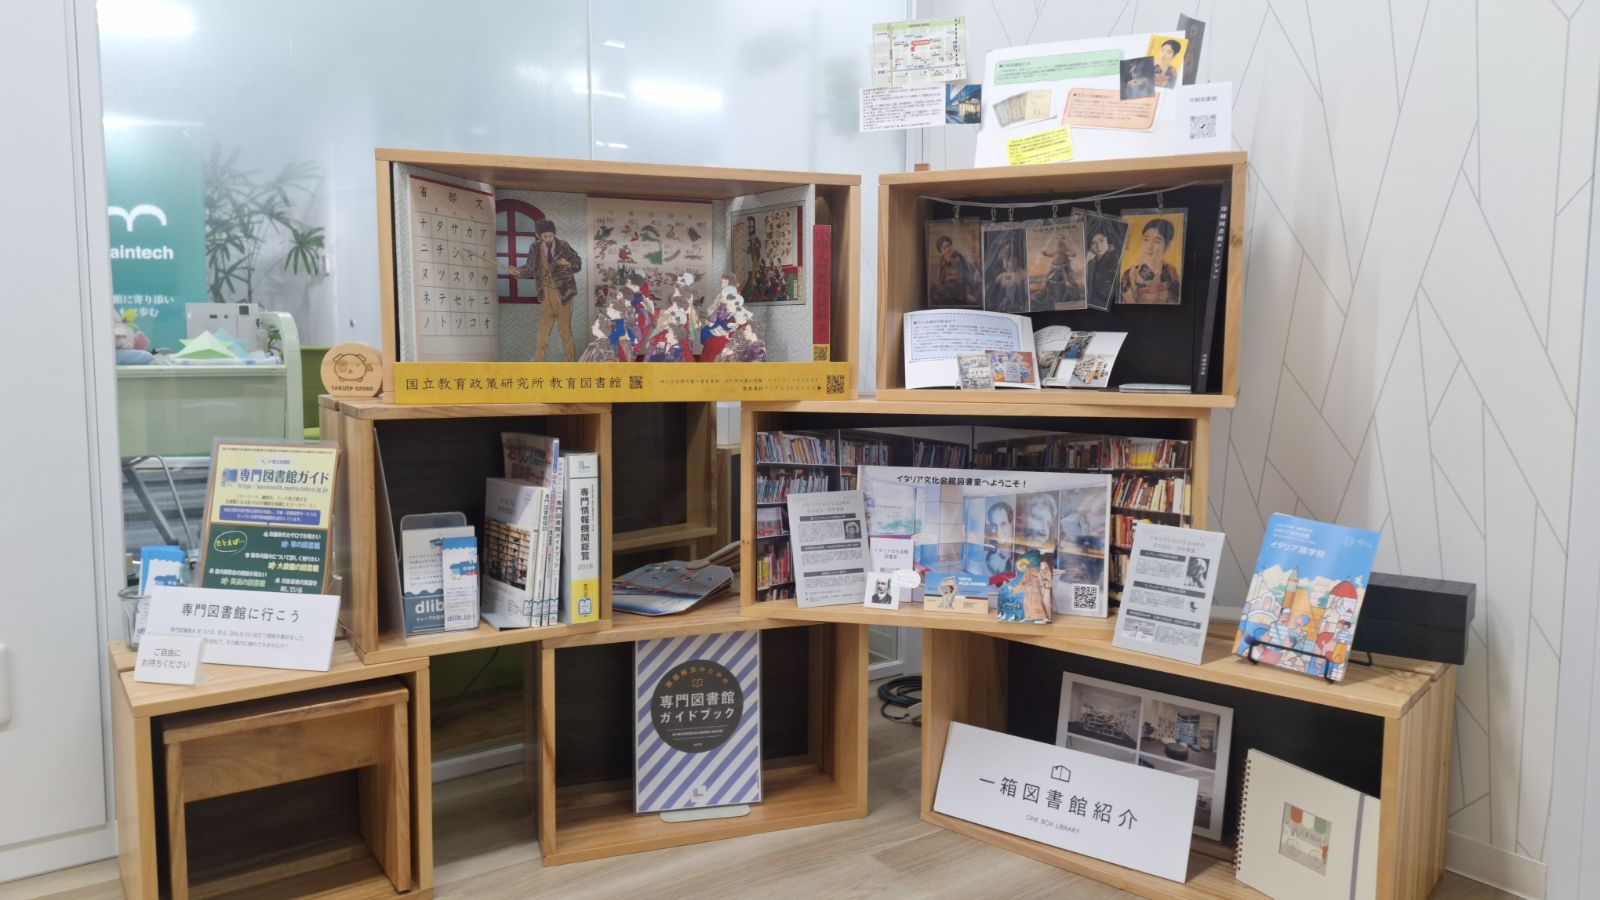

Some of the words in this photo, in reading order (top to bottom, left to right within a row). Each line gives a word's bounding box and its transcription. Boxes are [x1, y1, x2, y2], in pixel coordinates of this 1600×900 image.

[406, 377, 543, 391] 国立教育政策研究所
[550, 376, 622, 390] 教育図書館
[239, 468, 330, 486] 専門図書館ガイド
[579, 487, 591, 561] 専門情報機関総覧
[181, 602, 300, 623] 専門図書館に行こう
[153, 648, 182, 658] ご自由に
[140, 659, 191, 669] お持ちください
[660, 691, 735, 709] 専門図書館
[660, 708, 735, 724] ガイドブック
[978, 776, 1139, 831] 一箱図書館紹介
[1026, 814, 1039, 825] ONE
[1055, 822, 1081, 836] LIBRARY
